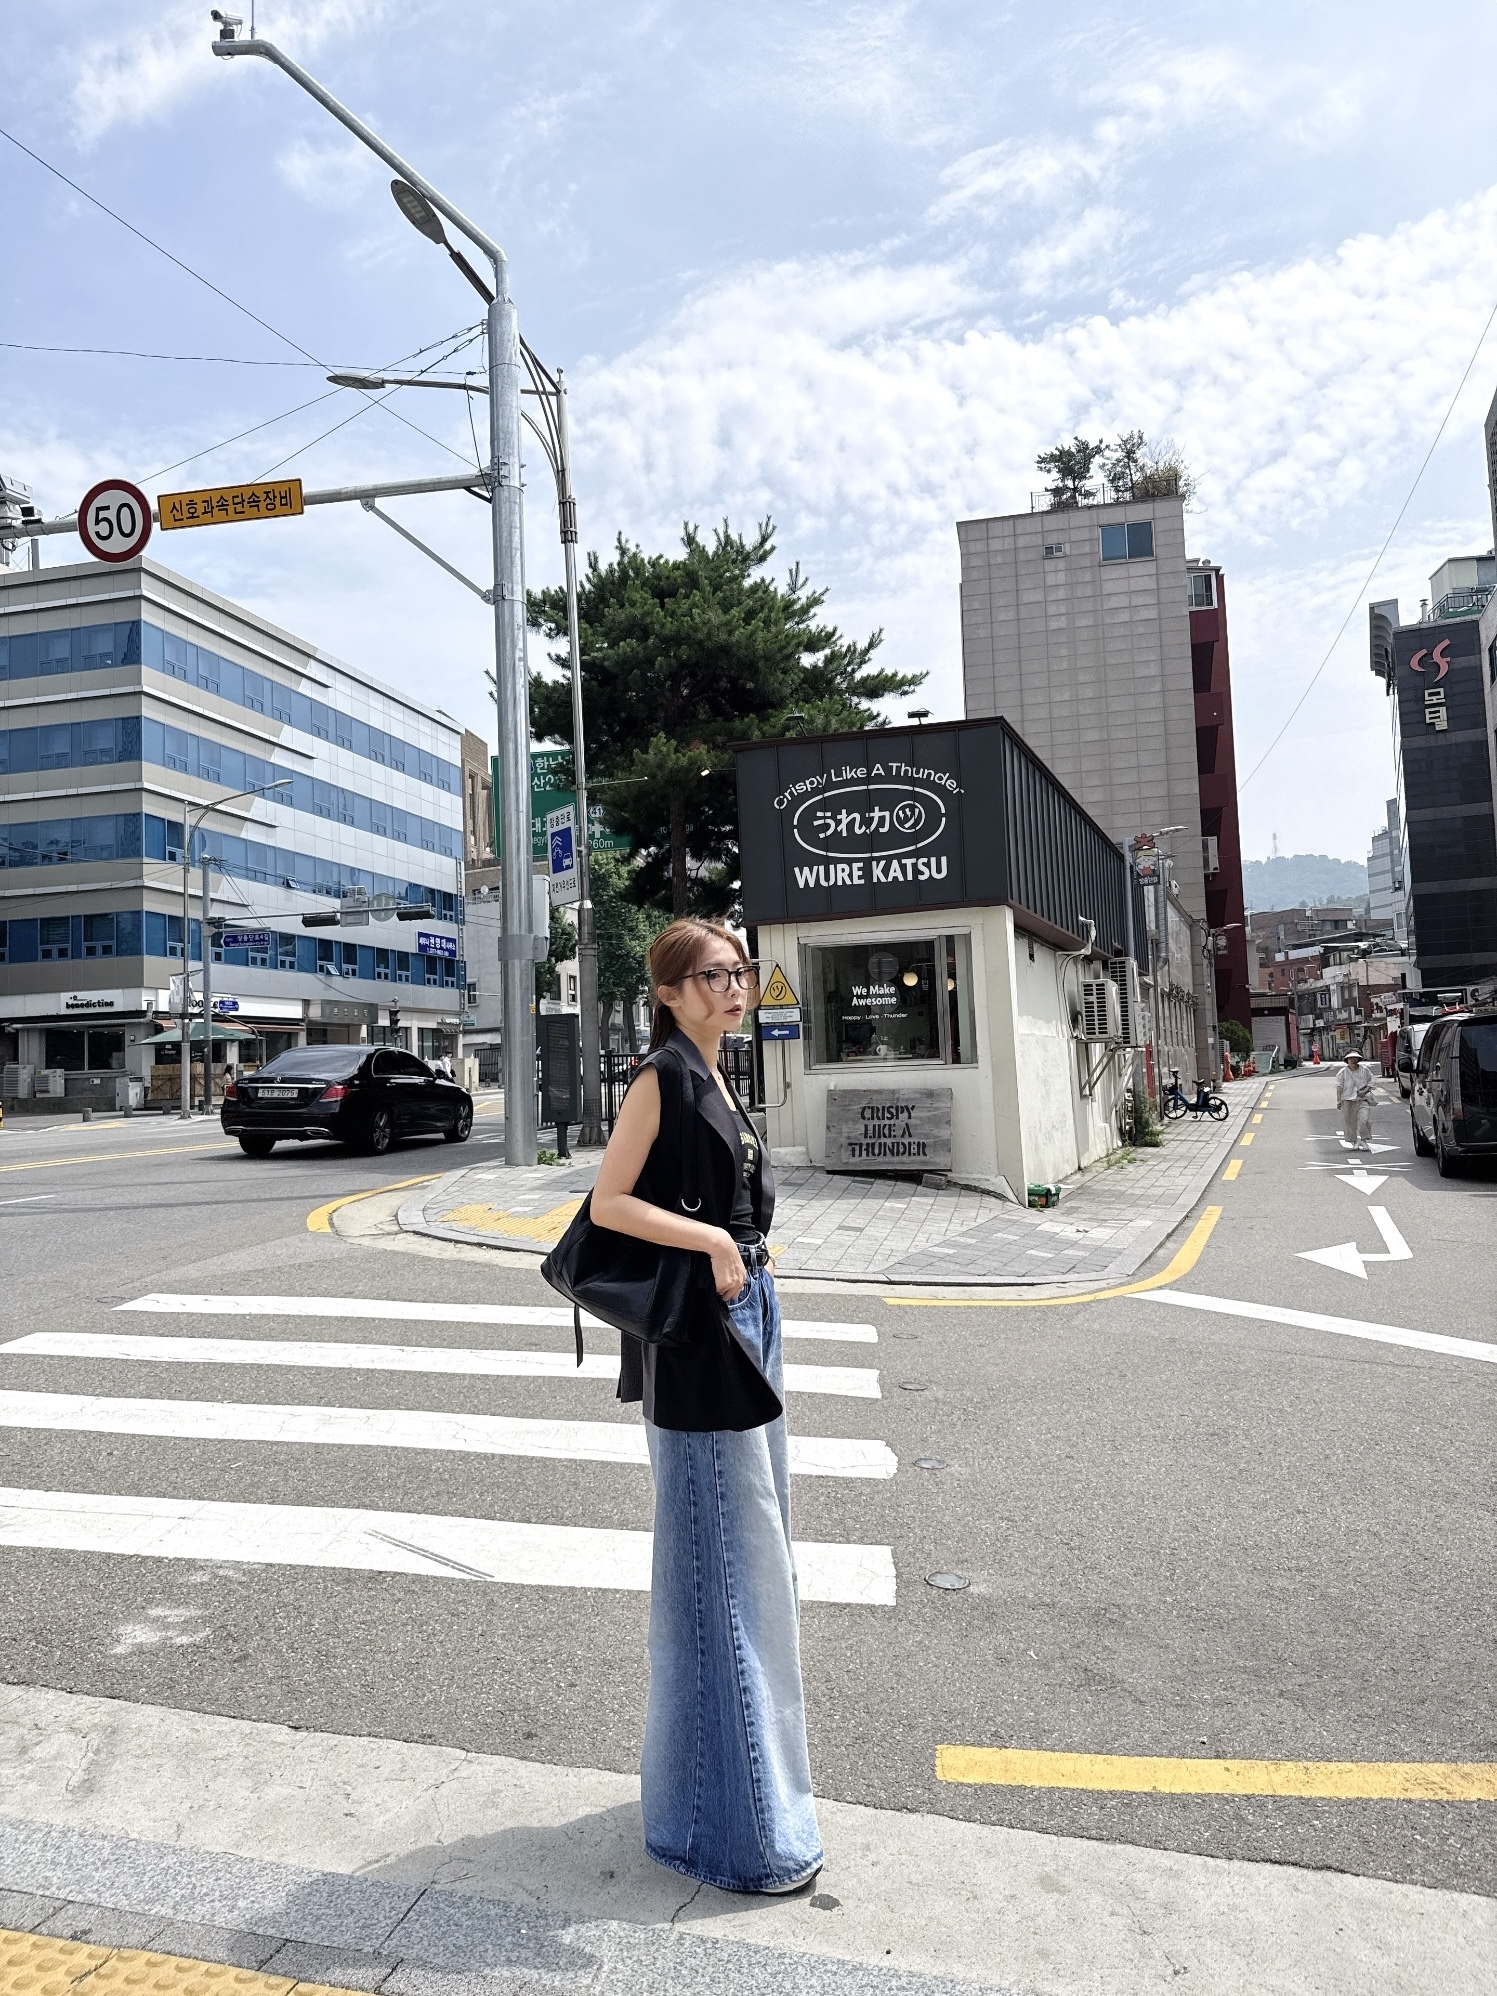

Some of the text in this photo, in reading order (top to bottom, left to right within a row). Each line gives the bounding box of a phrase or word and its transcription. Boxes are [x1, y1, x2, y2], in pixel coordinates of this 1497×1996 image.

[169, 486, 294, 524] 신호과속단속장비
[94, 502, 137, 541] 50
[1424, 687, 1449, 731] 모텔
[773, 762, 965, 810] Crispy Like A Thunder
[591, 807, 603, 817] 41
[794, 855, 948, 889] WURE KATSU
[852, 983, 896, 996] We Make
[851, 996, 897, 1007] Awesome
[277, 1089, 295, 1097] 2075
[860, 1104, 916, 1121] CRISPY
[863, 1122, 913, 1139] LIKE A
[848, 1141, 928, 1158] THUNDER
